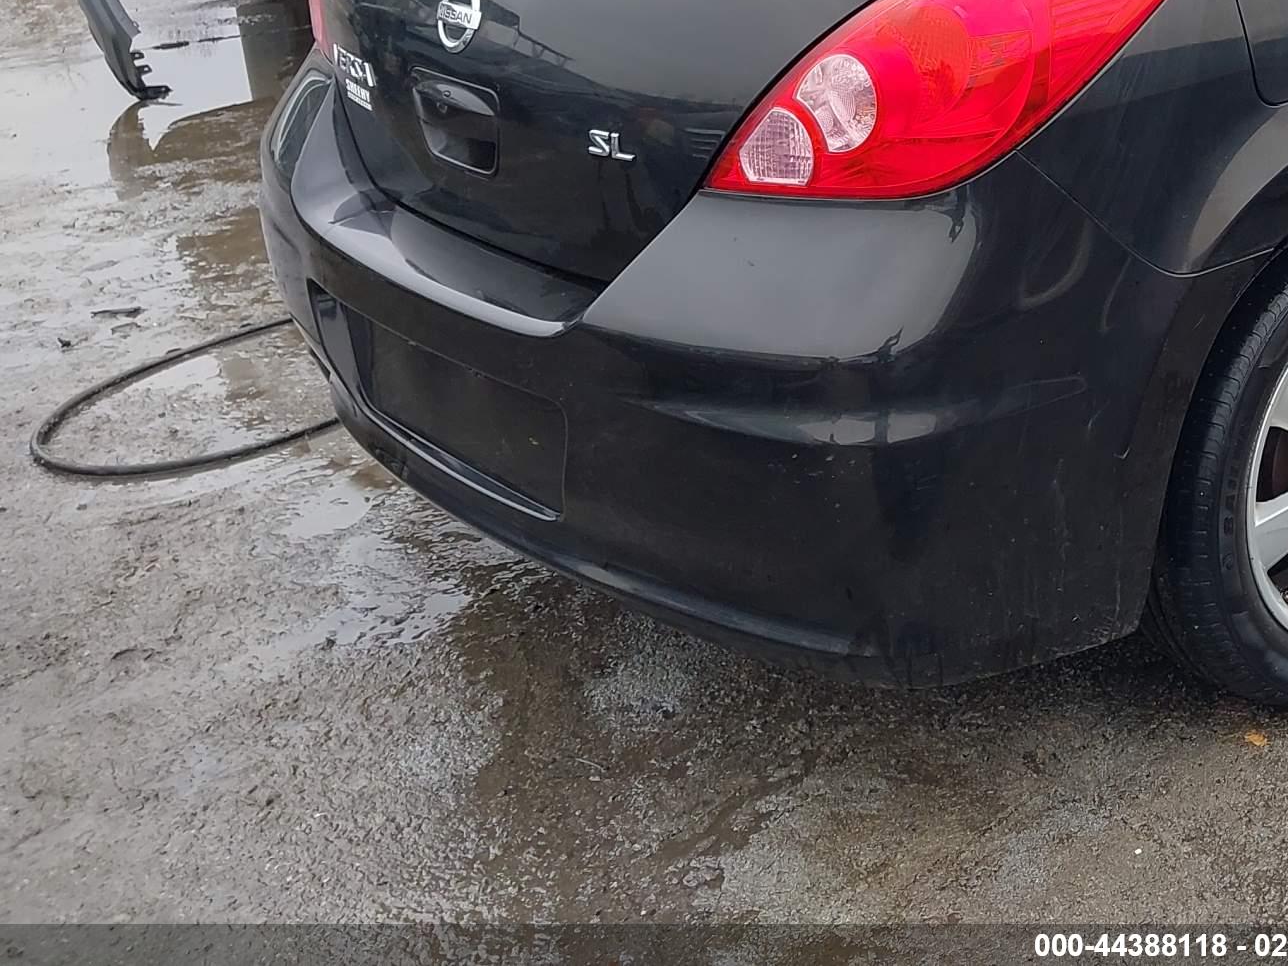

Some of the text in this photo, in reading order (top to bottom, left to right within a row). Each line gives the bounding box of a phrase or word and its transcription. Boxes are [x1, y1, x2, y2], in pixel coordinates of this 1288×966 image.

[439, 2, 473, 25] NISSAN
[333, 43, 377, 87] VERSA
[587, 128, 637, 161] SL
